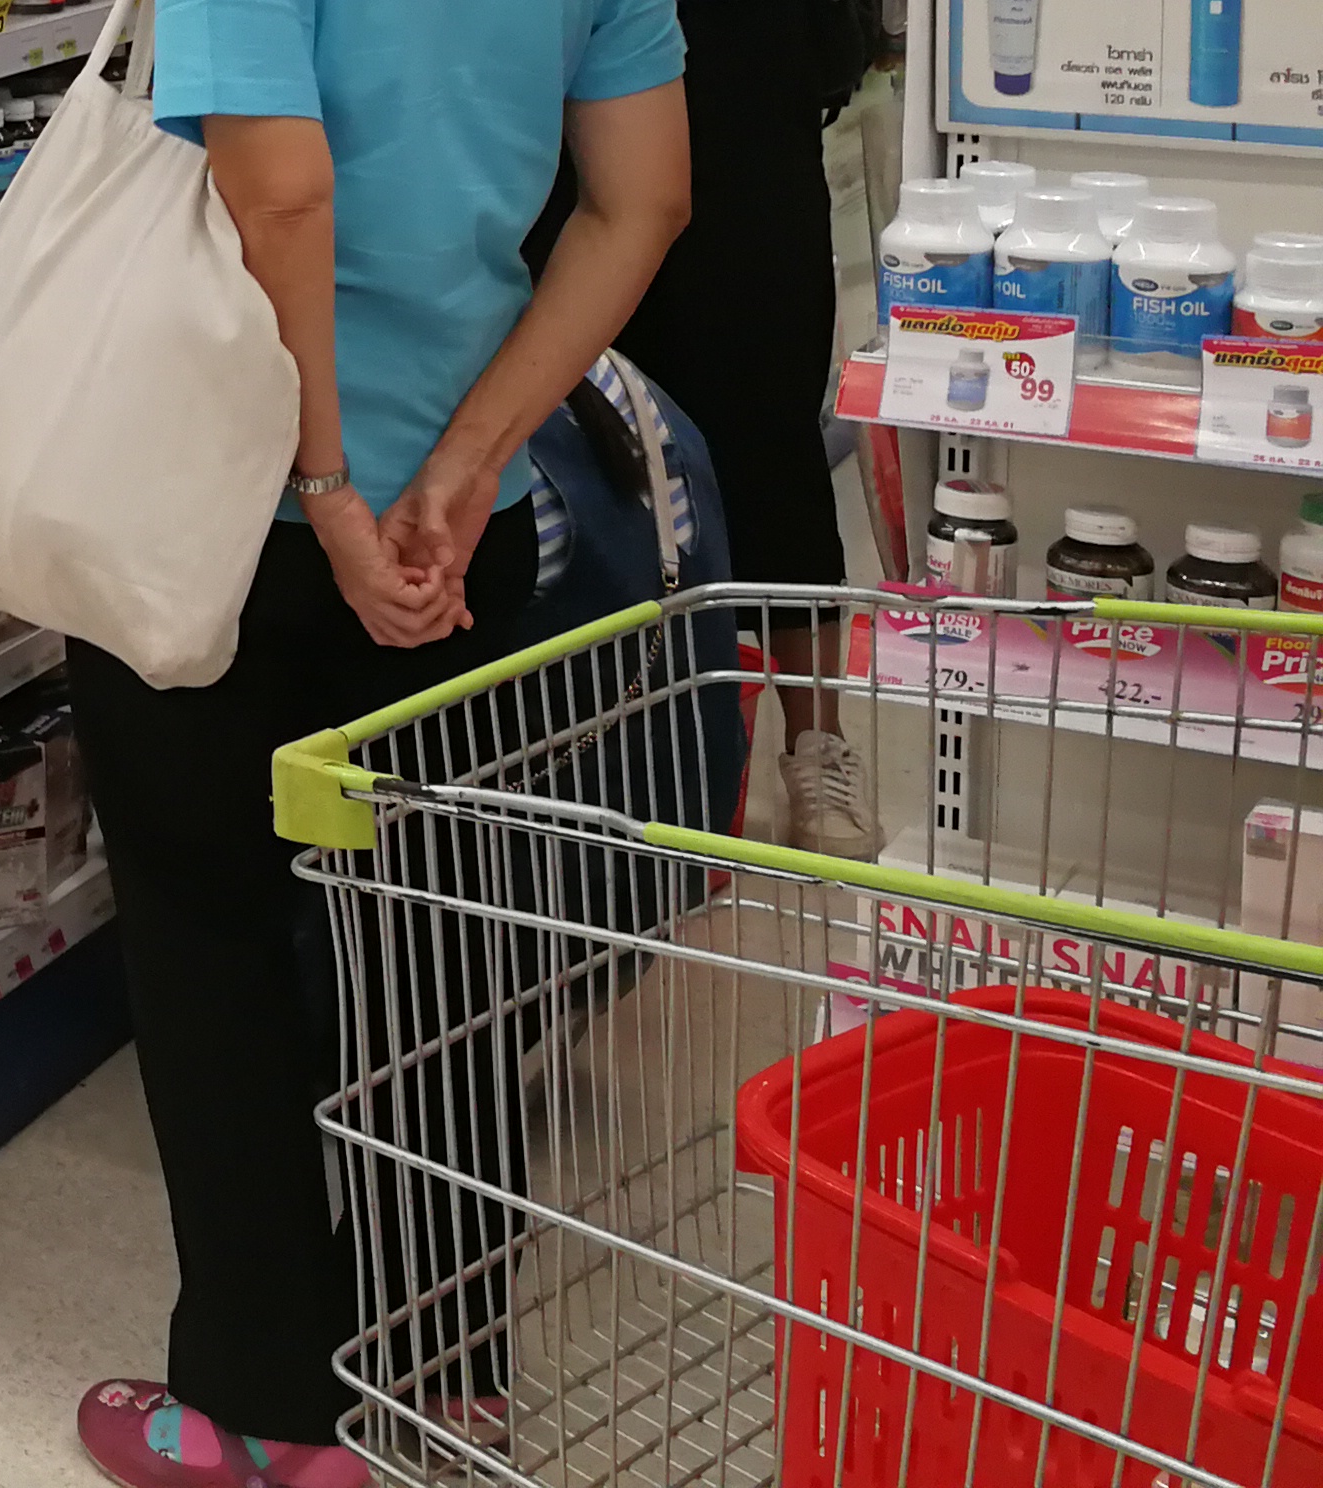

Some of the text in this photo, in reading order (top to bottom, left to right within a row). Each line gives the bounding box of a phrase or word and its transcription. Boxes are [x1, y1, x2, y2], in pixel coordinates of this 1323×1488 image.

[883, 272, 947, 293] FISH OIL
[1132, 296, 1210, 317] FISH OIL
[1020, 378, 1054, 402] 99
[942, 626, 973, 639] SALE
